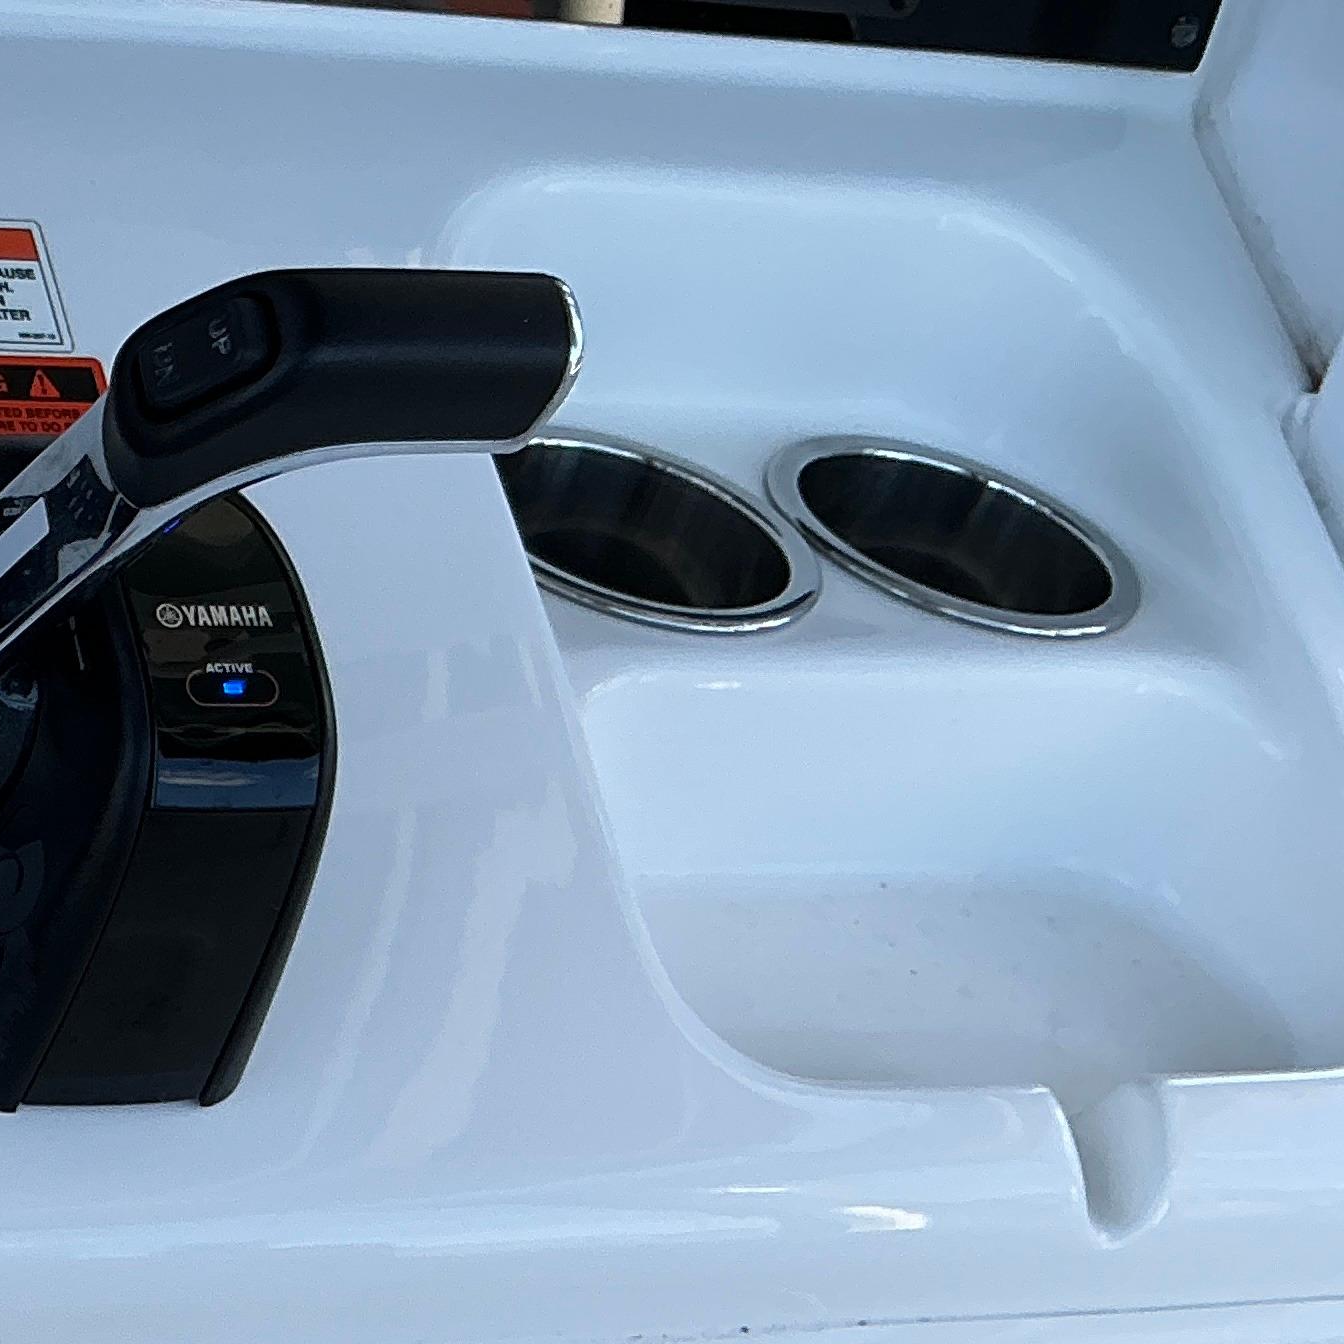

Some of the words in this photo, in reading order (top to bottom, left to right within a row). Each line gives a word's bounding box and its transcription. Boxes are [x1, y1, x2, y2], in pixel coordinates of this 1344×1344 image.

[19, 421, 38, 432] TO
[42, 422, 61, 433] DO
[181, 604, 274, 628] YAMAHA
[205, 662, 254, 674] ACTIVE
